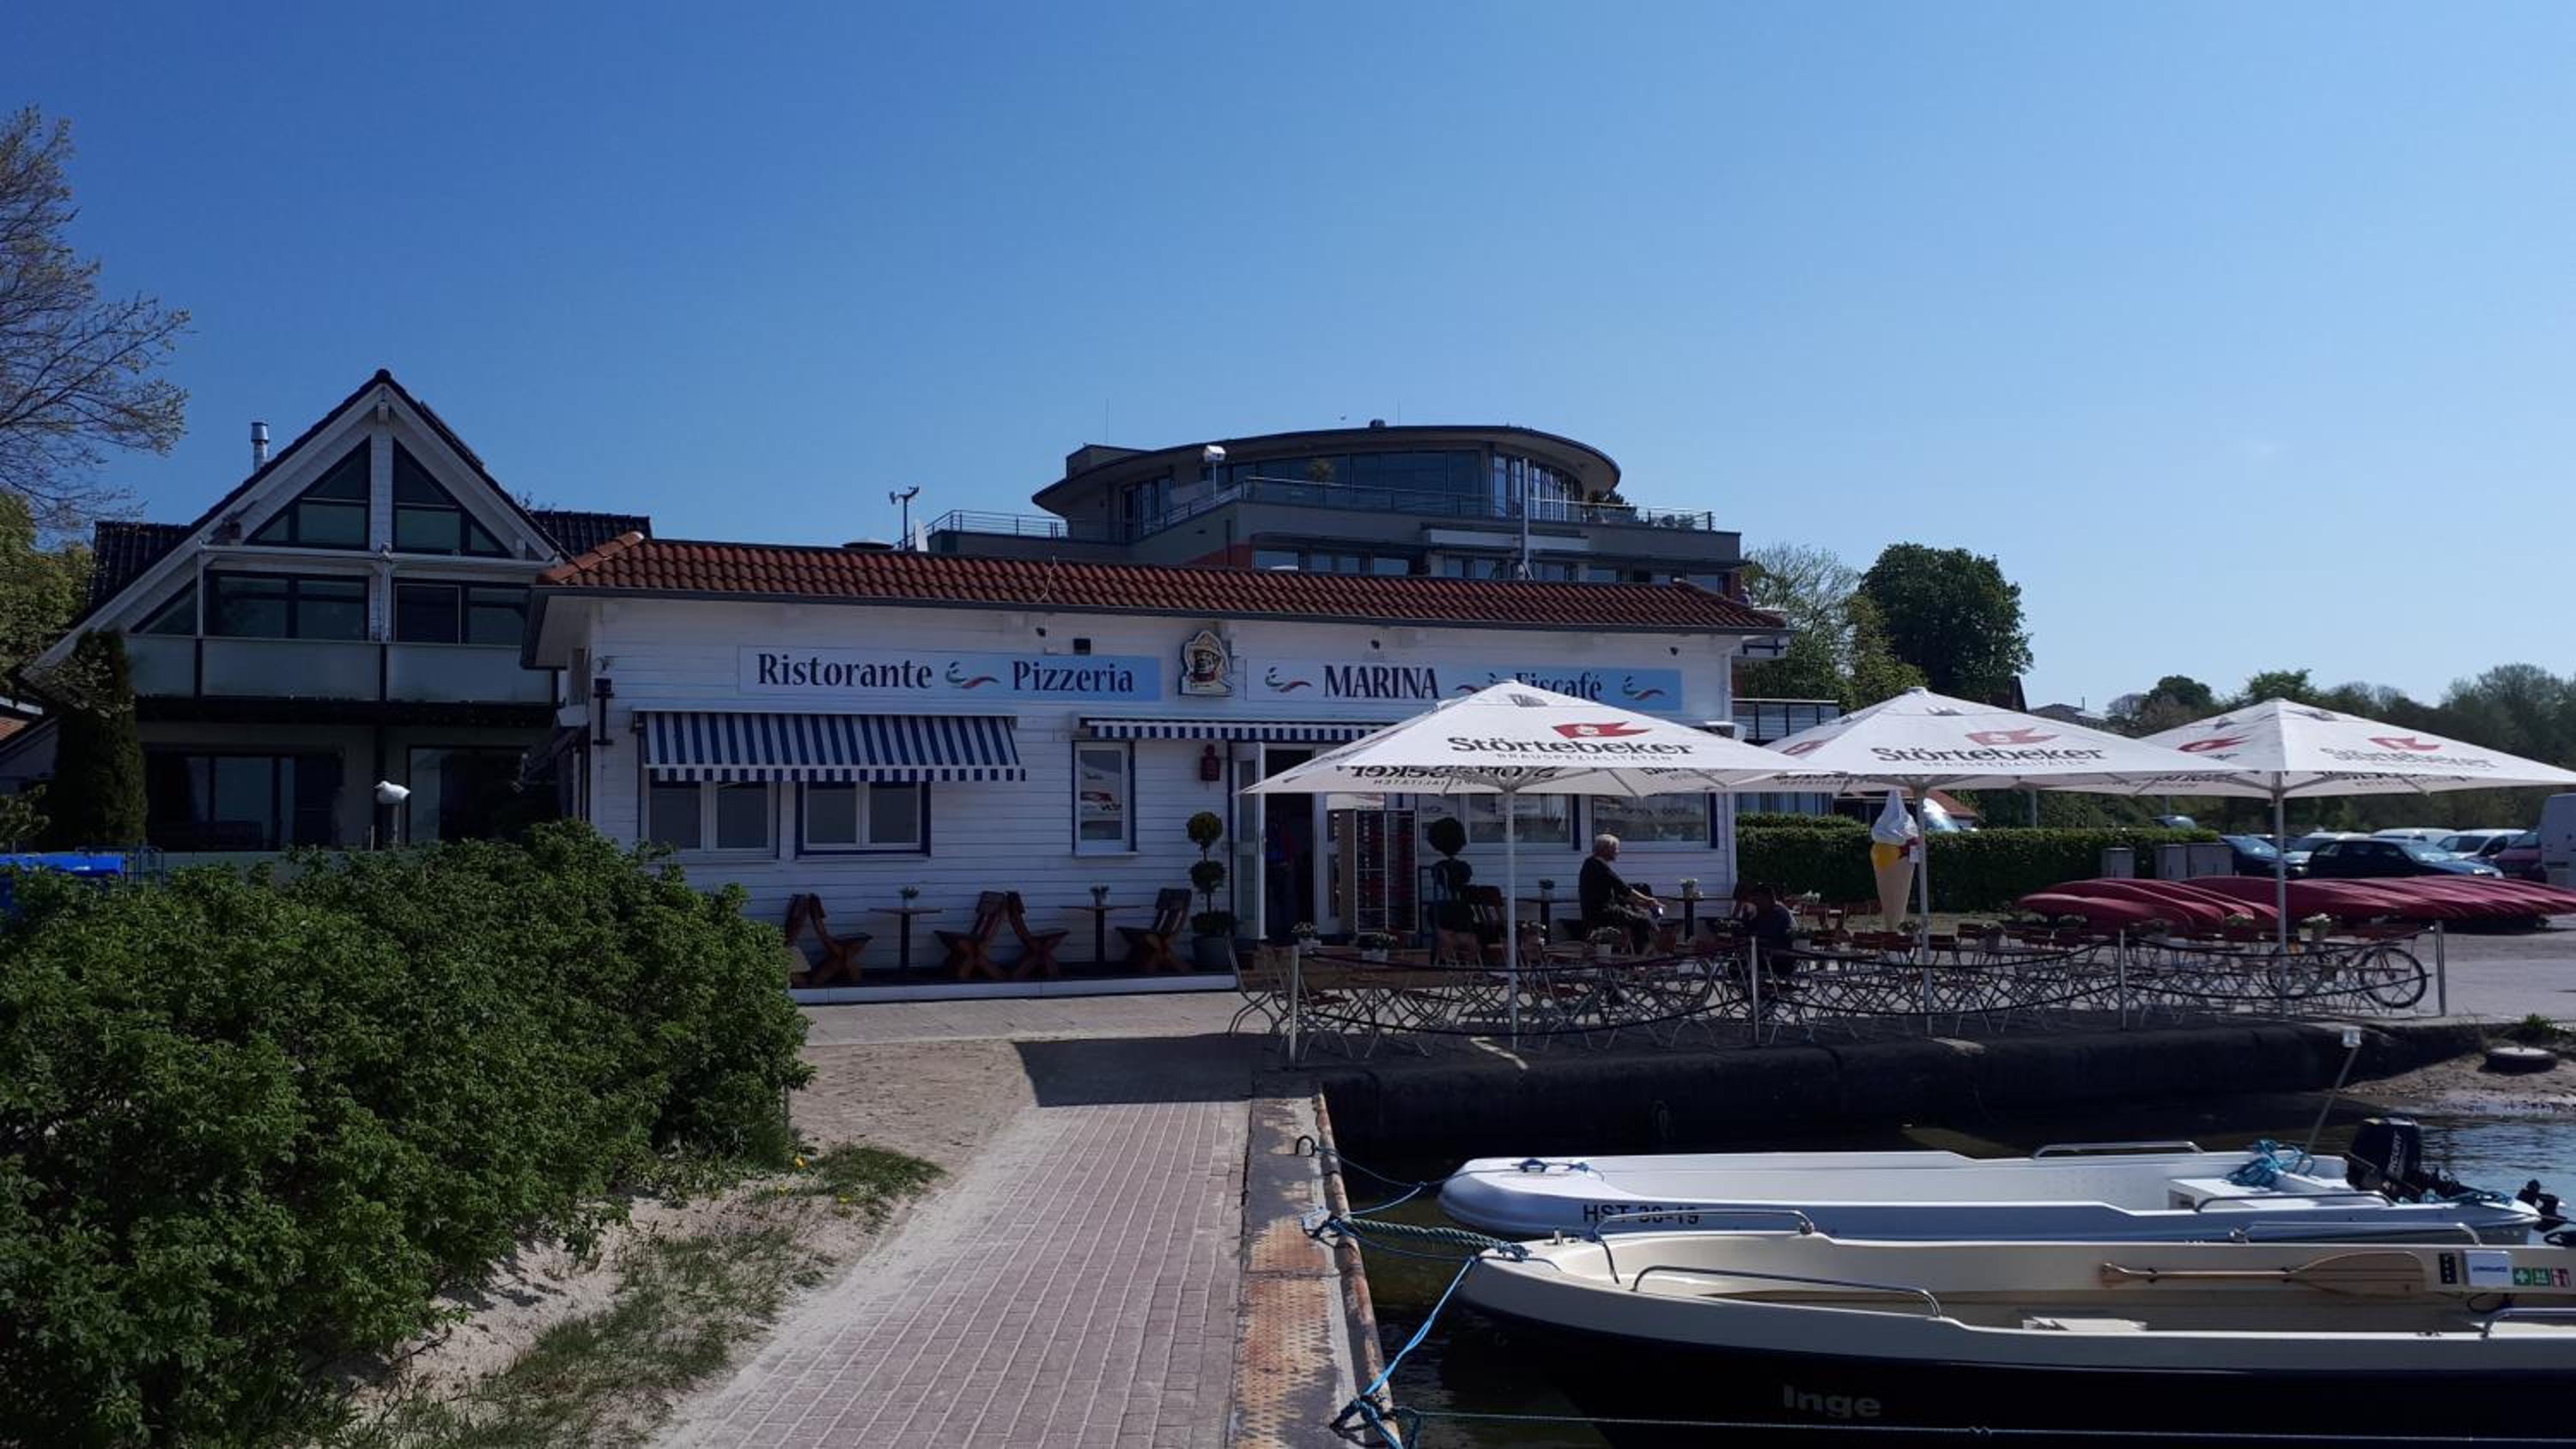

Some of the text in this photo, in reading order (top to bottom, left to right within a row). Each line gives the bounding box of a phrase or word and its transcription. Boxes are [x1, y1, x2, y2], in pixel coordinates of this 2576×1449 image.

[757, 652, 933, 689] Ristorante
[1012, 661, 1133, 694] Pizzeria
[1325, 665, 1439, 699] MARINA
[1446, 737, 1694, 755] Störtebeker
[1871, 747, 2107, 762] Störtebeker
[1583, 1204, 1630, 1223] HST
[1783, 1384, 1882, 1419] Inge
